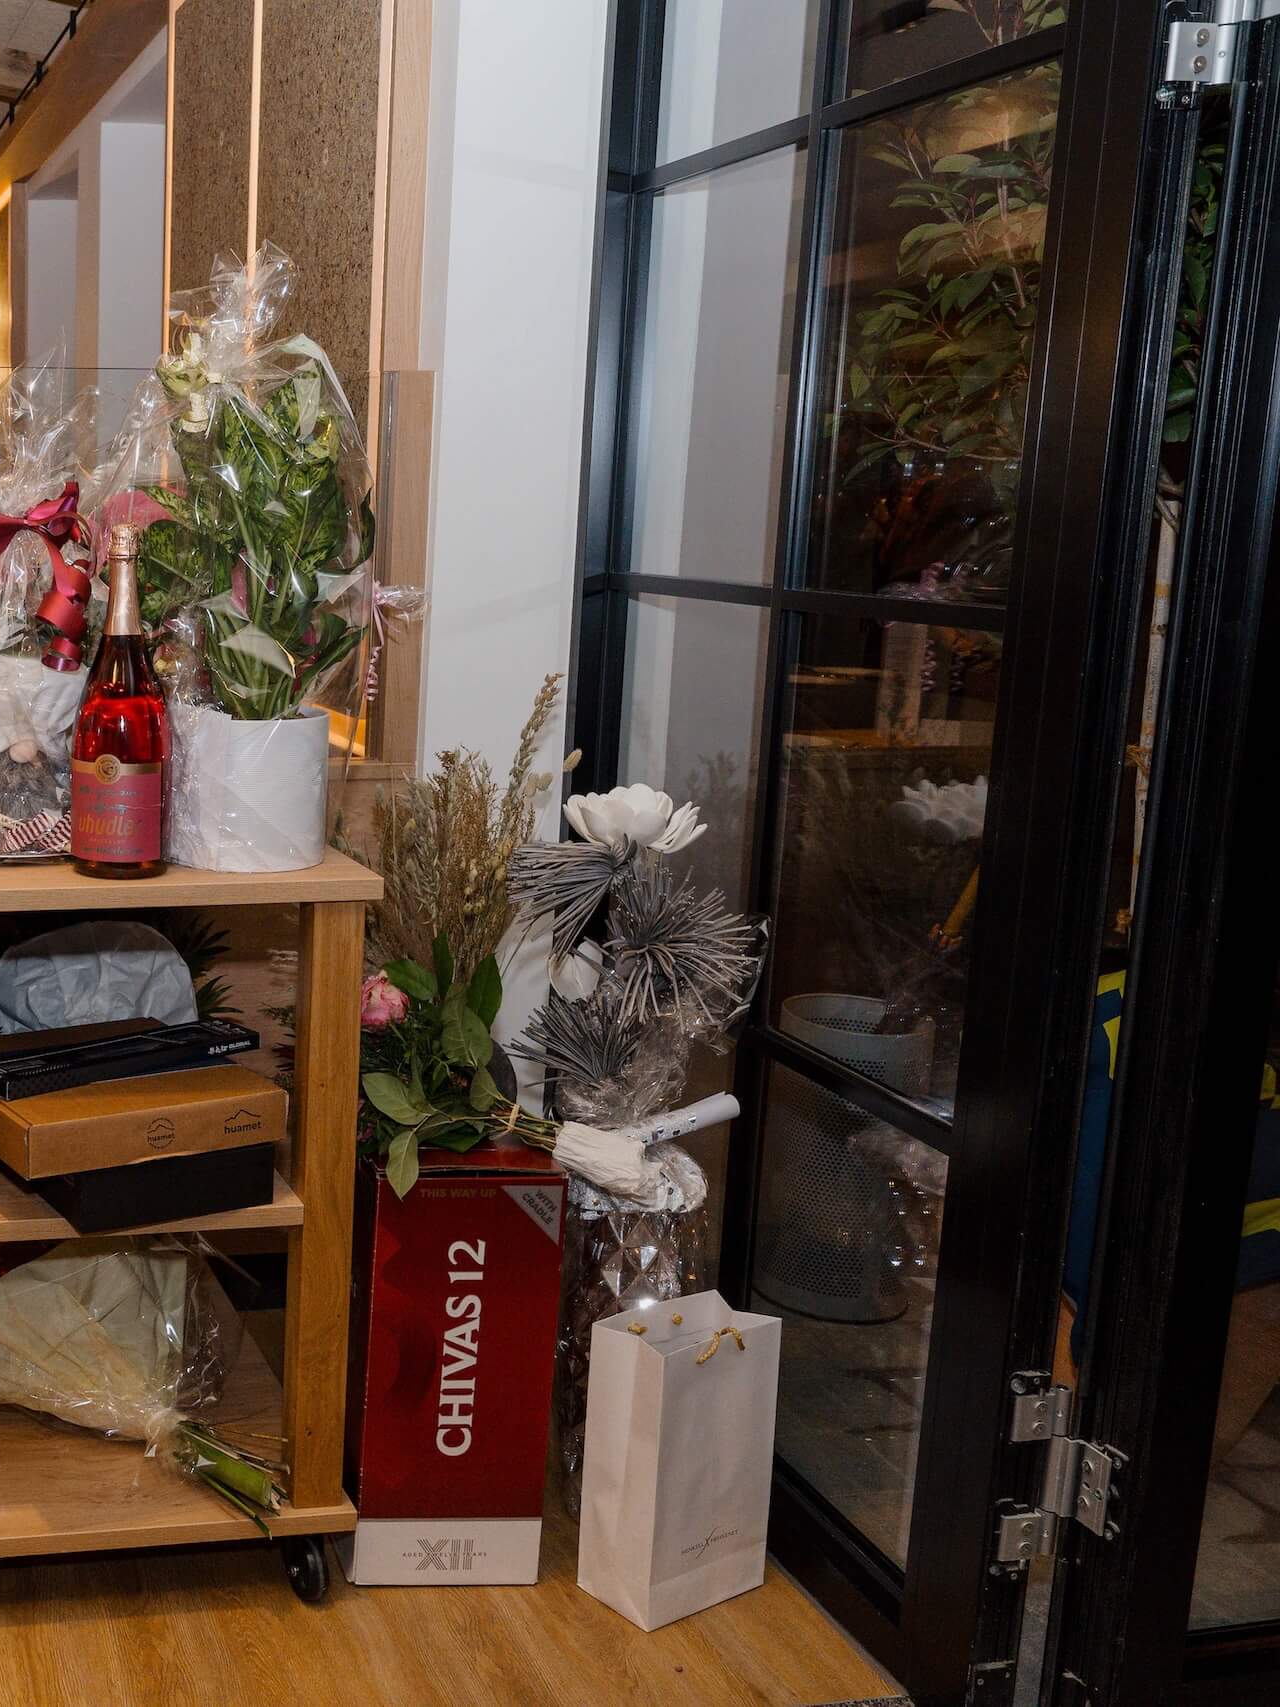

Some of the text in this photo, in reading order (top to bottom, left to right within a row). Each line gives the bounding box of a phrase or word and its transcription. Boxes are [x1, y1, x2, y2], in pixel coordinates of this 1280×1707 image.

[224, 1121, 262, 1135] huamet
[420, 1188, 497, 1198] THIS WAY UP
[534, 1188, 558, 1213] WITH
[521, 1193, 554, 1225] CRADLE
[436, 1239, 487, 1457] CHIVAS 12
